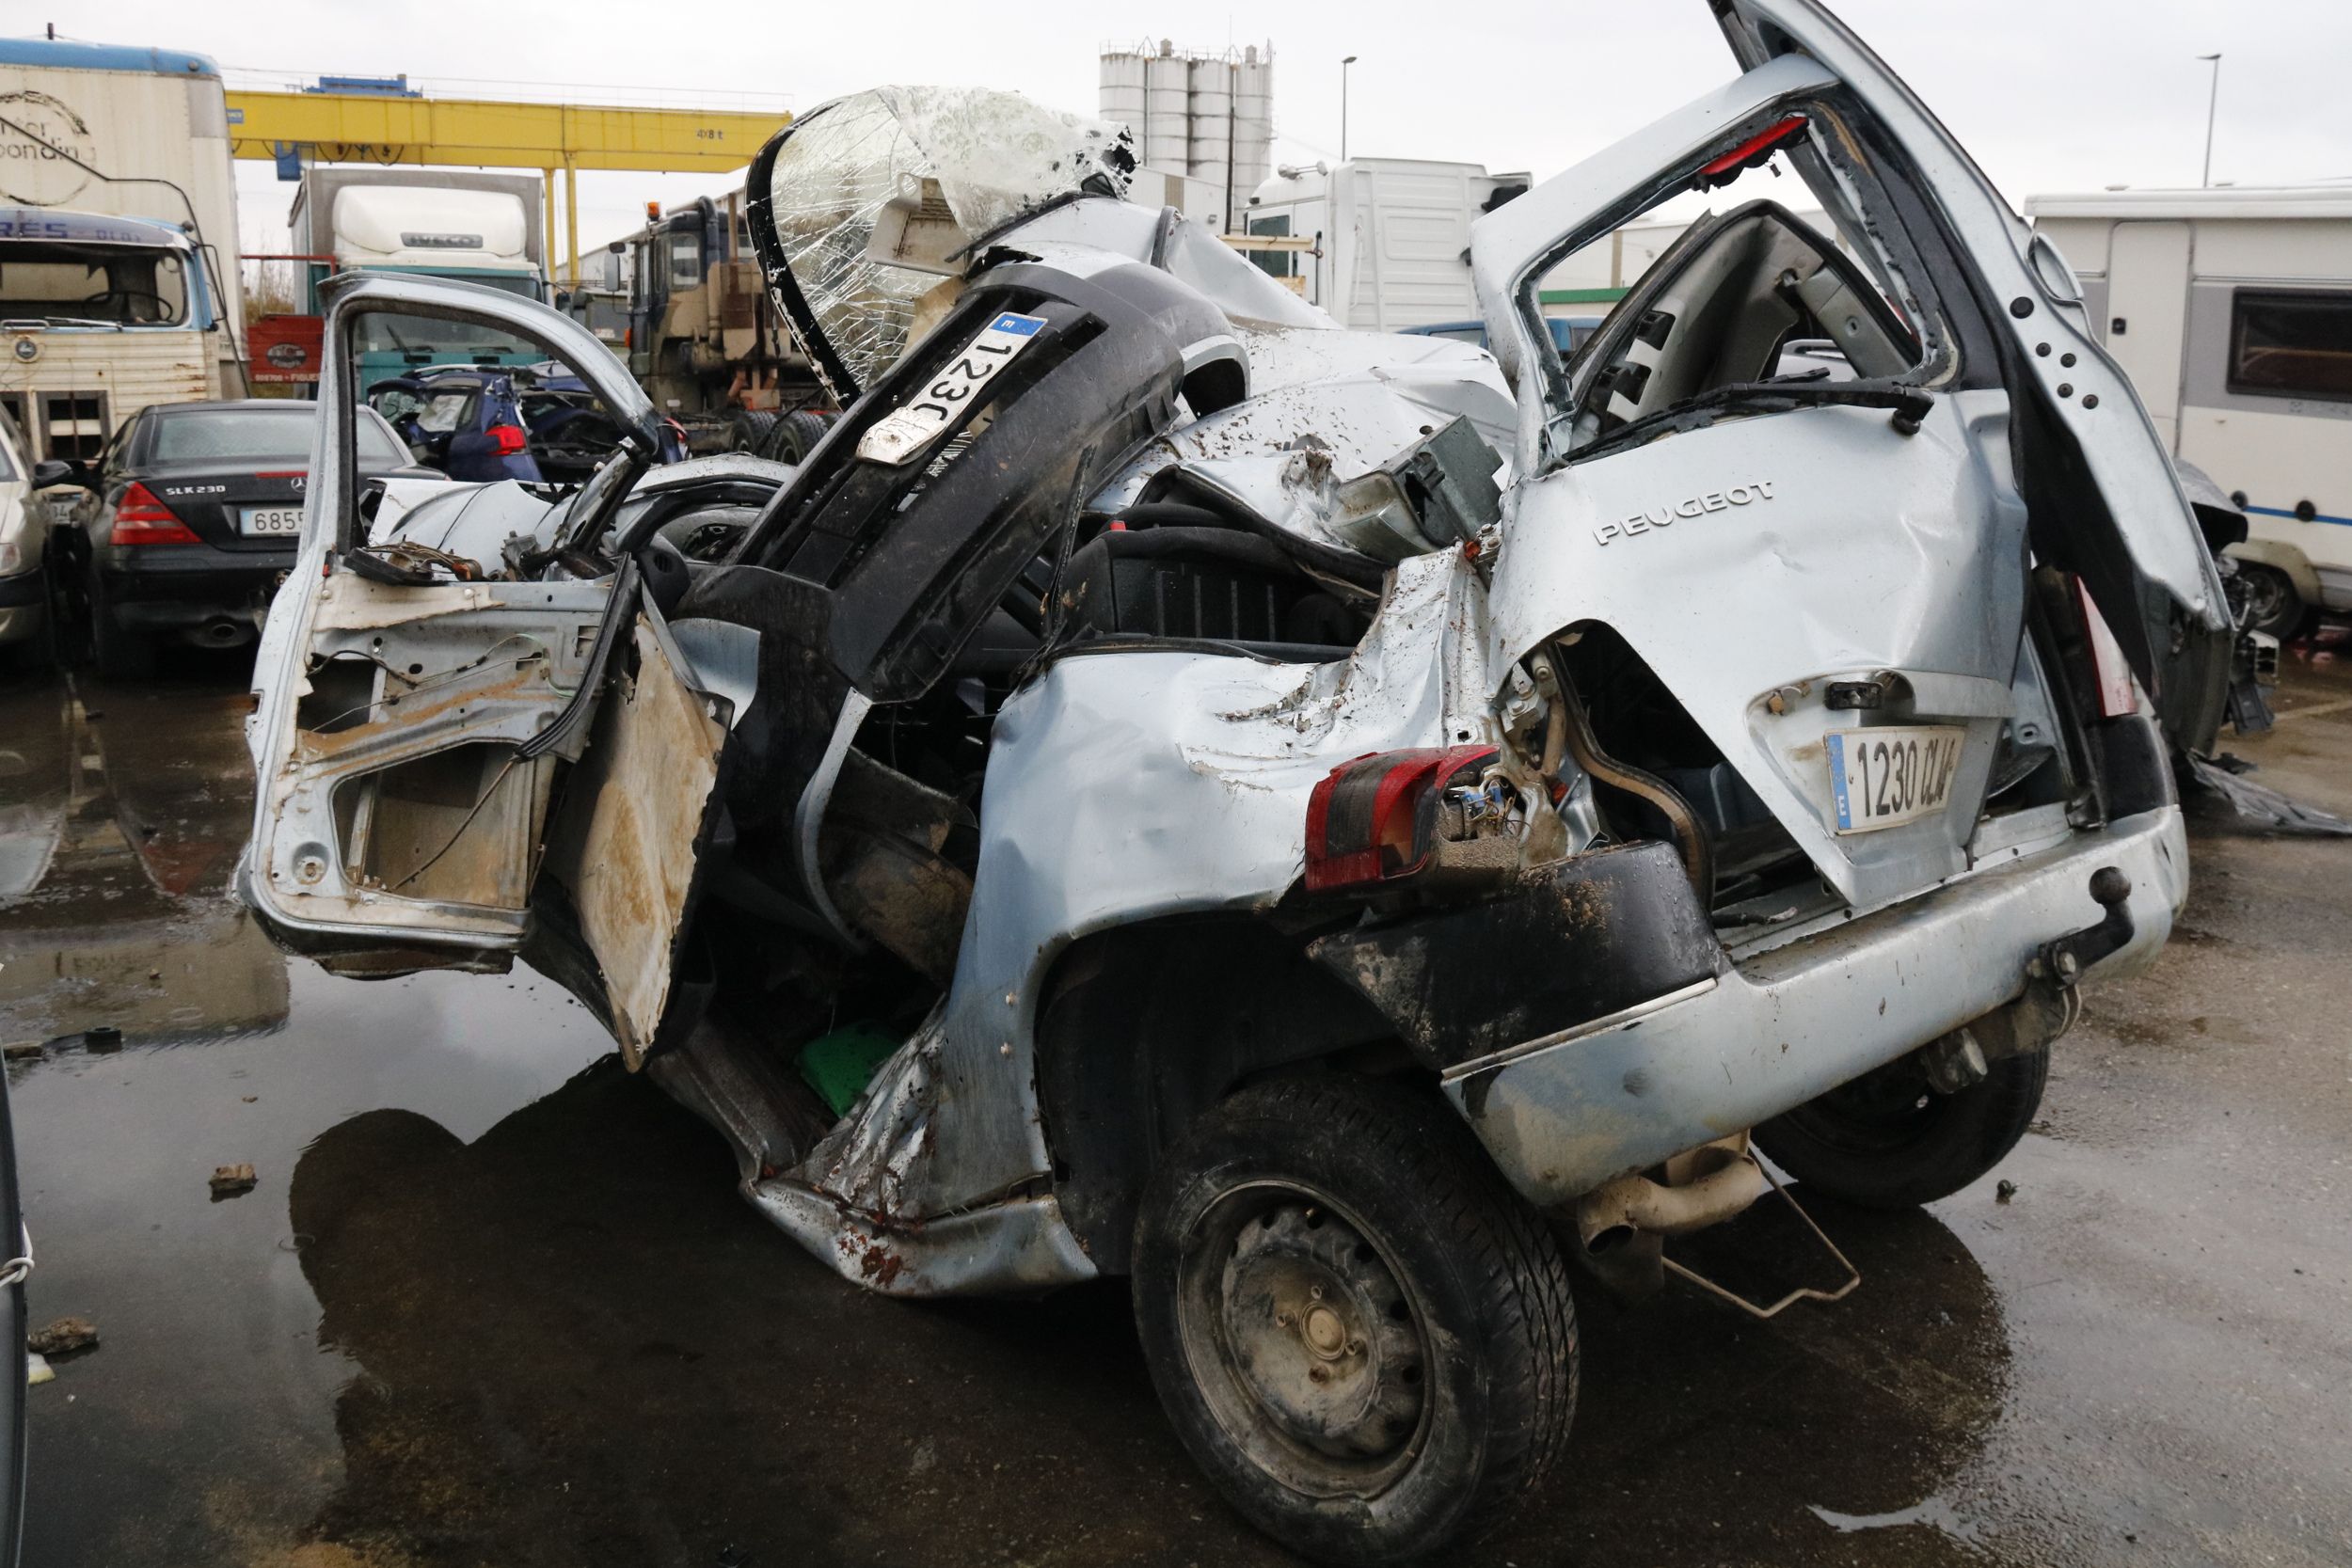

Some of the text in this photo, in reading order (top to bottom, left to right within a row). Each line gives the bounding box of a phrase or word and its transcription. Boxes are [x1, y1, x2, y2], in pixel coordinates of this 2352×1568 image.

[1001, 319, 1015, 328] E
[166, 484, 227, 496] SLK 230
[1593, 482, 1773, 546] PEUGEOT
[1857, 739, 1917, 817] 1230
[1837, 795, 1847, 816] E
